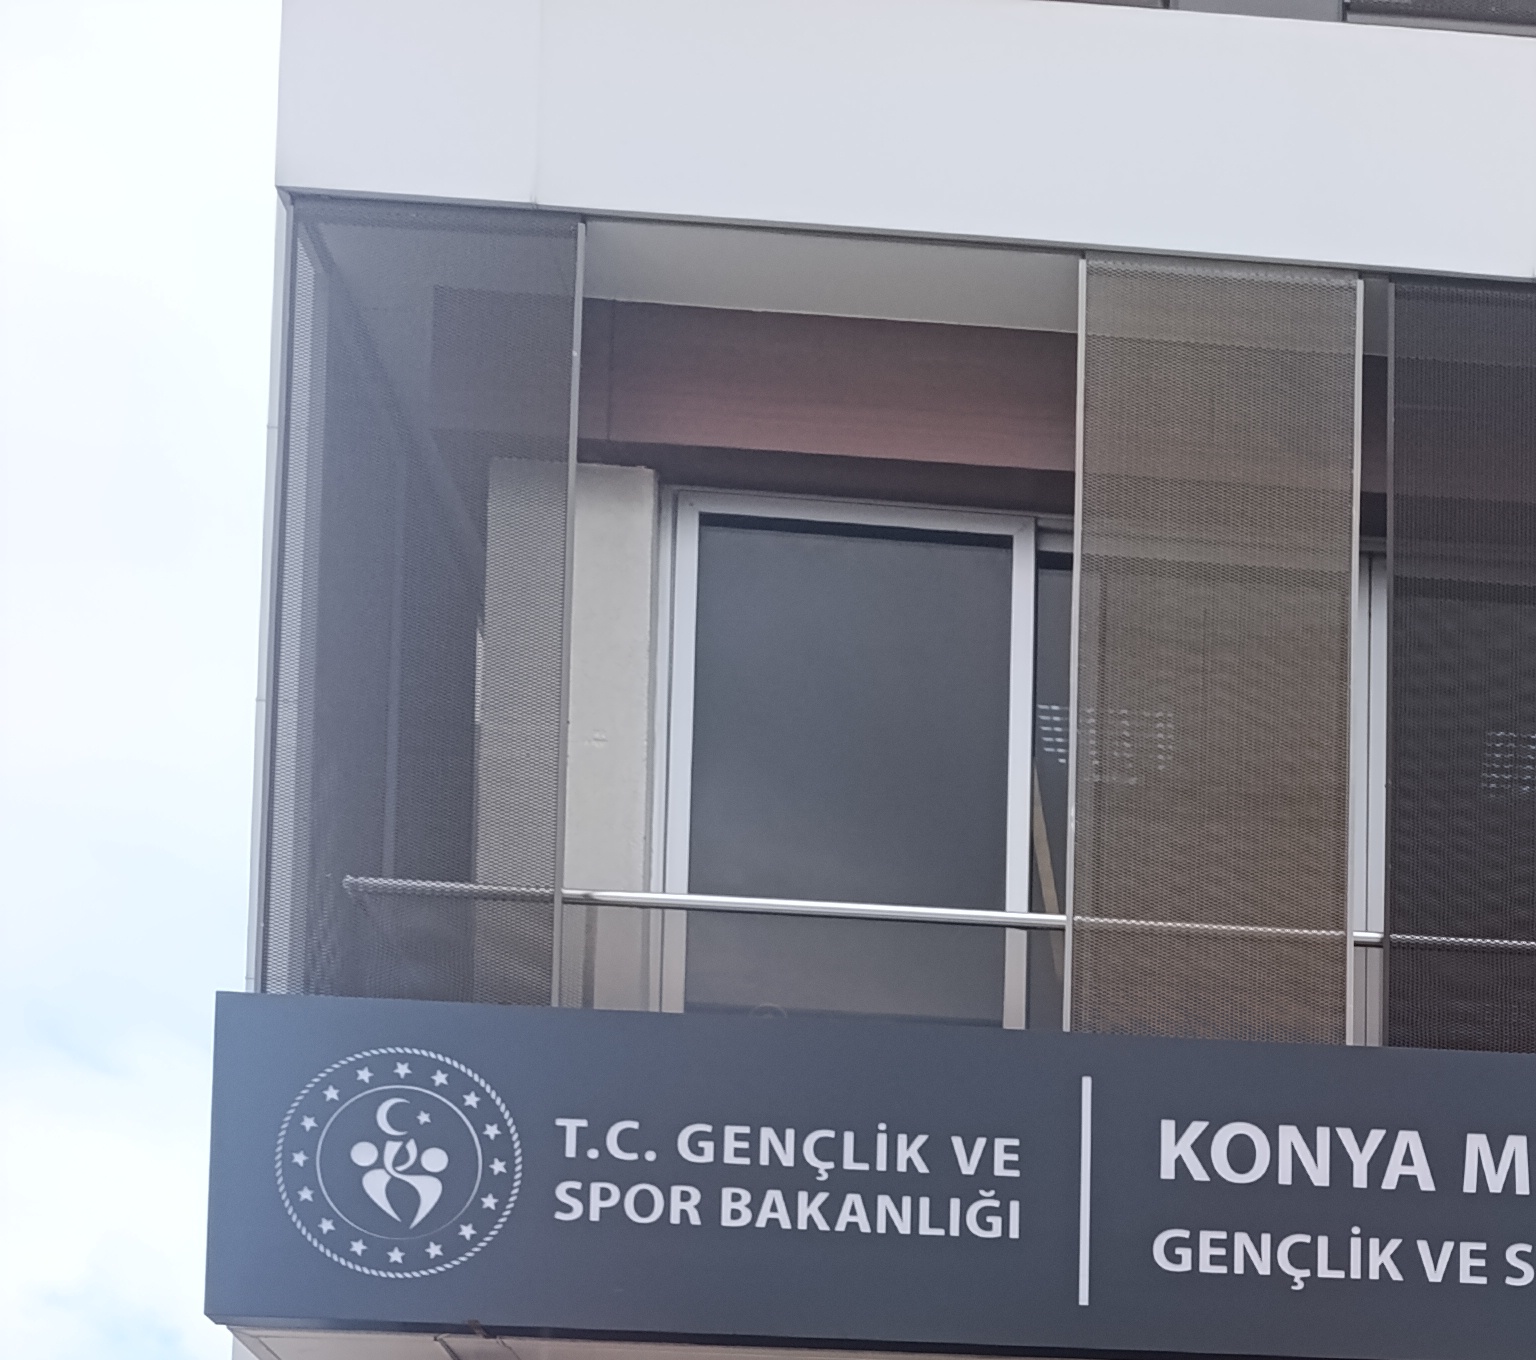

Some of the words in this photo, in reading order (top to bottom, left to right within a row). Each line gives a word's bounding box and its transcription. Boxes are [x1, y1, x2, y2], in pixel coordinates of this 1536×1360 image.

[555, 1118, 657, 1162] T.C.
[676, 1122, 930, 1181] GENÇLİK
[950, 1135, 1021, 1178] VE
[1160, 1119, 1436, 1192] KONYA
[554, 1180, 702, 1226] SPOR
[720, 1187, 1020, 1239] BAKANLIĞI
[1152, 1225, 1404, 1291] GENÇLİK
[1416, 1239, 1488, 1285] VE
